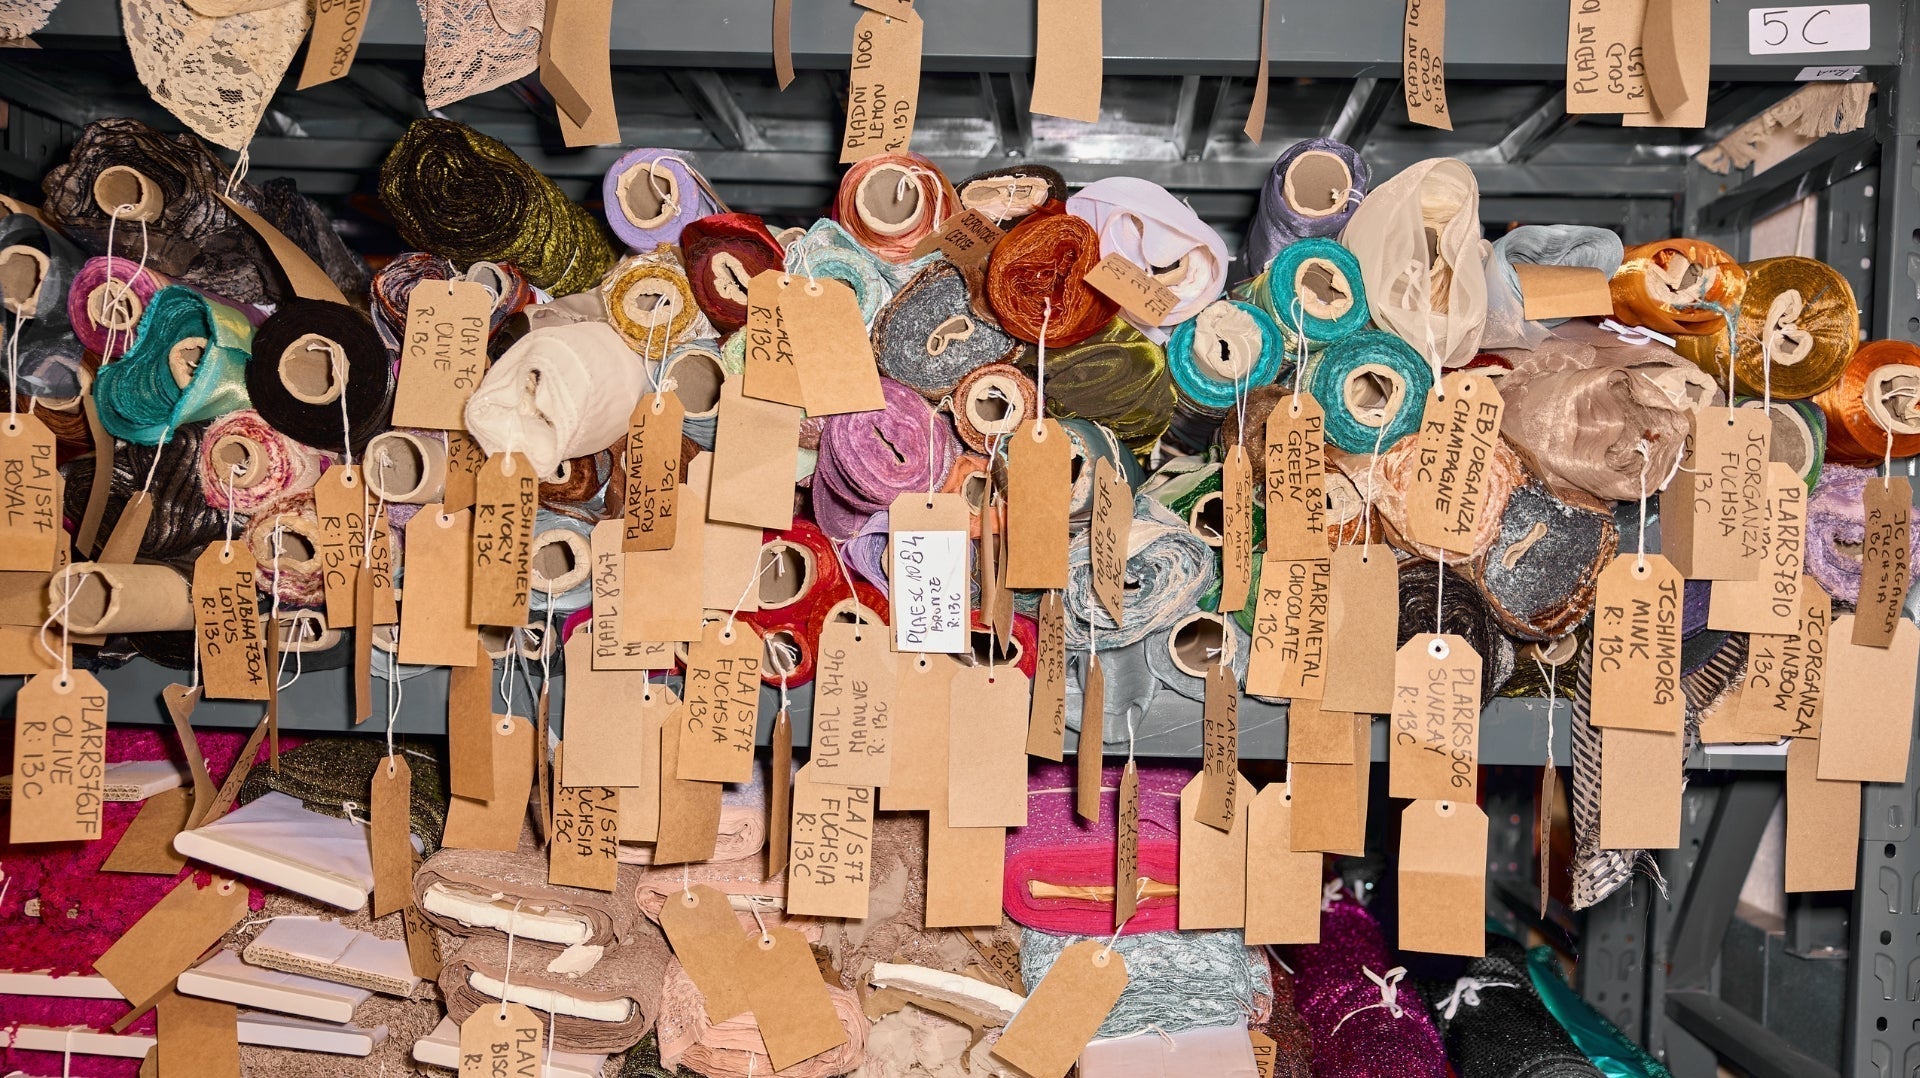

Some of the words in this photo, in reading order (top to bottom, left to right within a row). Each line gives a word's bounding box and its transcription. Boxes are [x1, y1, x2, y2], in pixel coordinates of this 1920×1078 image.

[853, 30, 873, 70] 1006
[1407, 33, 1422, 108] PLADNT
[1573, 22, 1599, 94] PLADNT
[1606, 42, 1627, 94] GOLD
[1628, 46, 1645, 78] 13D
[1421, 48, 1432, 102] GOLD
[1432, 56, 1443, 91] 13D
[847, 81, 868, 149] PLADNT
[868, 84, 887, 140] LEMON
[893, 100, 910, 130] 13D
[885, 135, 905, 152] R:
[944, 229, 975, 250] CERISE
[460, 317, 484, 356] PLAX
[750, 305, 772, 324] R:
[410, 332, 430, 358] 13C
[434, 322, 454, 372] OLIVE
[751, 327, 772, 362] 13C
[454, 364, 479, 390] 76
[1268, 443, 1284, 463] R:
[1304, 416, 1322, 484] PLAAL
[1425, 420, 1445, 443] R:
[626, 414, 647, 540] PLARRMETAL
[660, 458, 678, 493] 13C
[1286, 430, 1303, 503] GREEN
[1418, 448, 1438, 484] 13C
[1436, 398, 1470, 515] CHAMPAGNE
[1451, 401, 1499, 536] EB/ORGANZA
[4, 459, 24, 528] ROYAL
[641, 484, 658, 533] RUST
[660, 497, 673, 519] R:
[1234, 480, 1242, 508] SEA
[1268, 467, 1285, 505] 13C
[1718, 451, 1740, 538] FUCHSIA
[1741, 429, 1766, 559] JCORGANZA
[480, 505, 496, 525] R:
[499, 503, 516, 565] IVORY
[1306, 487, 1324, 535] 8347
[476, 533, 493, 567] 13C
[512, 477, 535, 608] EBSHIMMER
[1234, 529, 1243, 571] MIST
[1771, 487, 1800, 618] PLARRS7810
[1876, 523, 1892, 604] FUCHSIA
[596, 552, 621, 598] 8347
[1262, 588, 1282, 607] R:
[201, 596, 217, 618] R:
[218, 586, 239, 645] LOTUS
[928, 576, 944, 633] BRONZE
[1280, 562, 1307, 664] CHOCOLATE
[1300, 557, 1330, 688] PLARRMETAL
[1603, 606, 1624, 626] R:
[206, 622, 222, 658] 13C
[1254, 613, 1278, 654] 13C
[1629, 598, 1652, 660] MINK
[1654, 578, 1678, 706] JCSHIMORG
[822, 648, 846, 697] 8446
[1046, 622, 1057, 692] PETROL
[1599, 636, 1624, 674] 13C
[1750, 648, 1776, 690] 13C
[1773, 619, 1804, 712] AINBOW
[1791, 606, 1824, 734] JCORGANZA
[692, 668, 711, 690] R:
[712, 659, 734, 744] FUCHSIA
[1396, 686, 1419, 705] R:
[22, 721, 47, 744] R:
[688, 695, 708, 734] 13C
[874, 700, 888, 730] 13C
[1396, 708, 1418, 746] 13C
[1423, 668, 1448, 758] SUNRAY
[1450, 668, 1476, 790] PLARRS506
[50, 715, 73, 786] OLIVE
[1216, 722, 1226, 775] LIME
[20, 754, 45, 800] 13C
[556, 810, 576, 844] 13C
[594, 786, 618, 860] A/S77
[796, 812, 817, 833] R:
[815, 797, 841, 886] FUCHSIA
[793, 840, 815, 878] 13C
